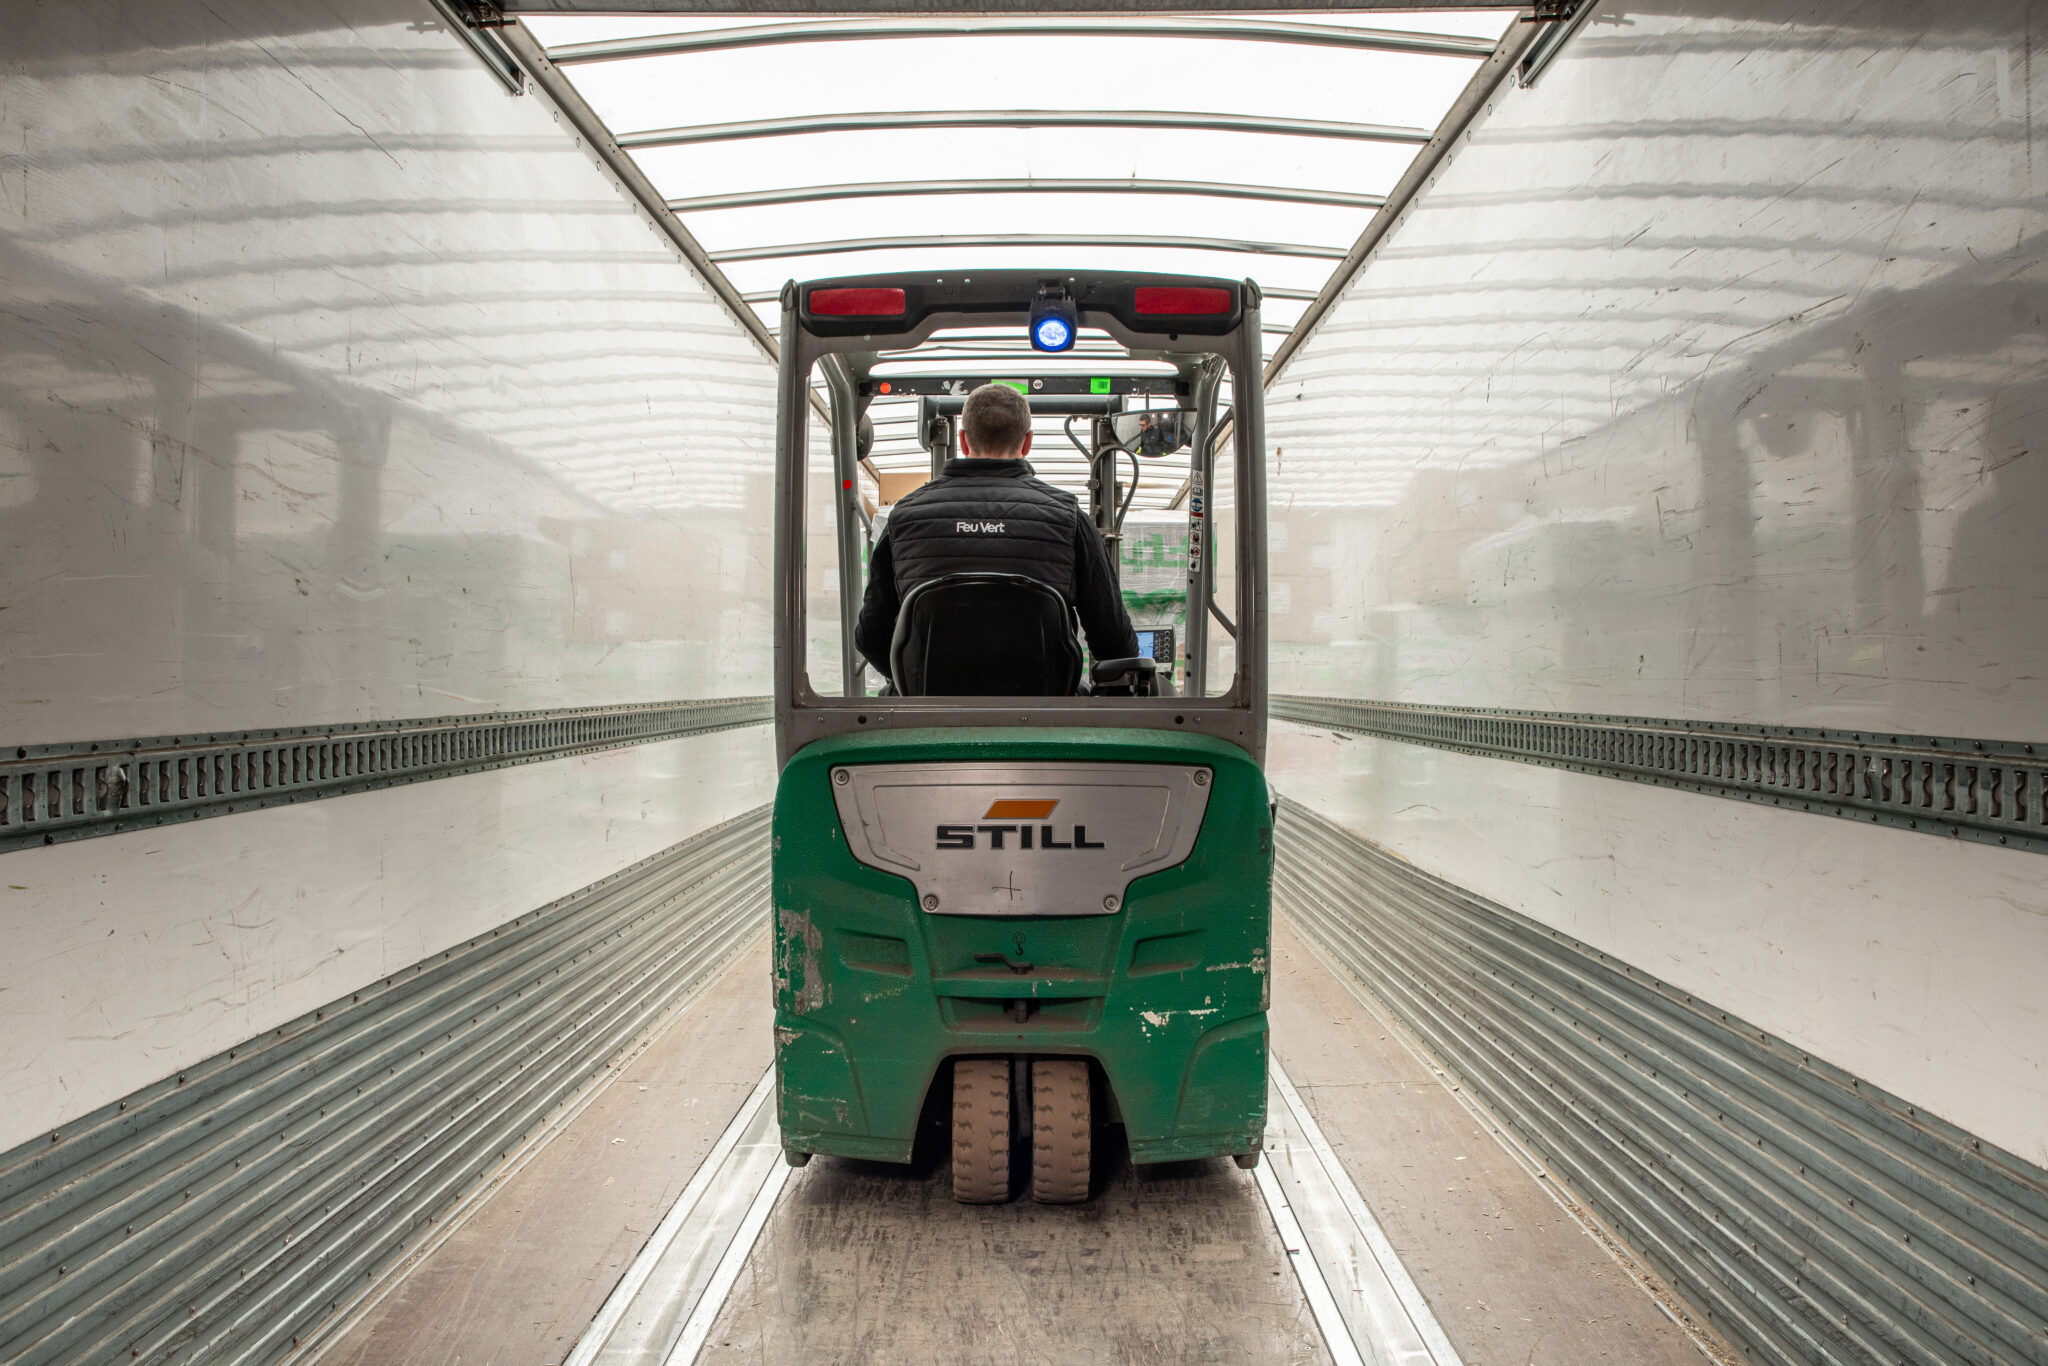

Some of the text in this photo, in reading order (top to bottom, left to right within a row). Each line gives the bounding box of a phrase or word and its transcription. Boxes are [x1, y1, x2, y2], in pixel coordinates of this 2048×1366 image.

[956, 521, 1005, 533] Feu Vert
[936, 825, 1105, 849] STILL
